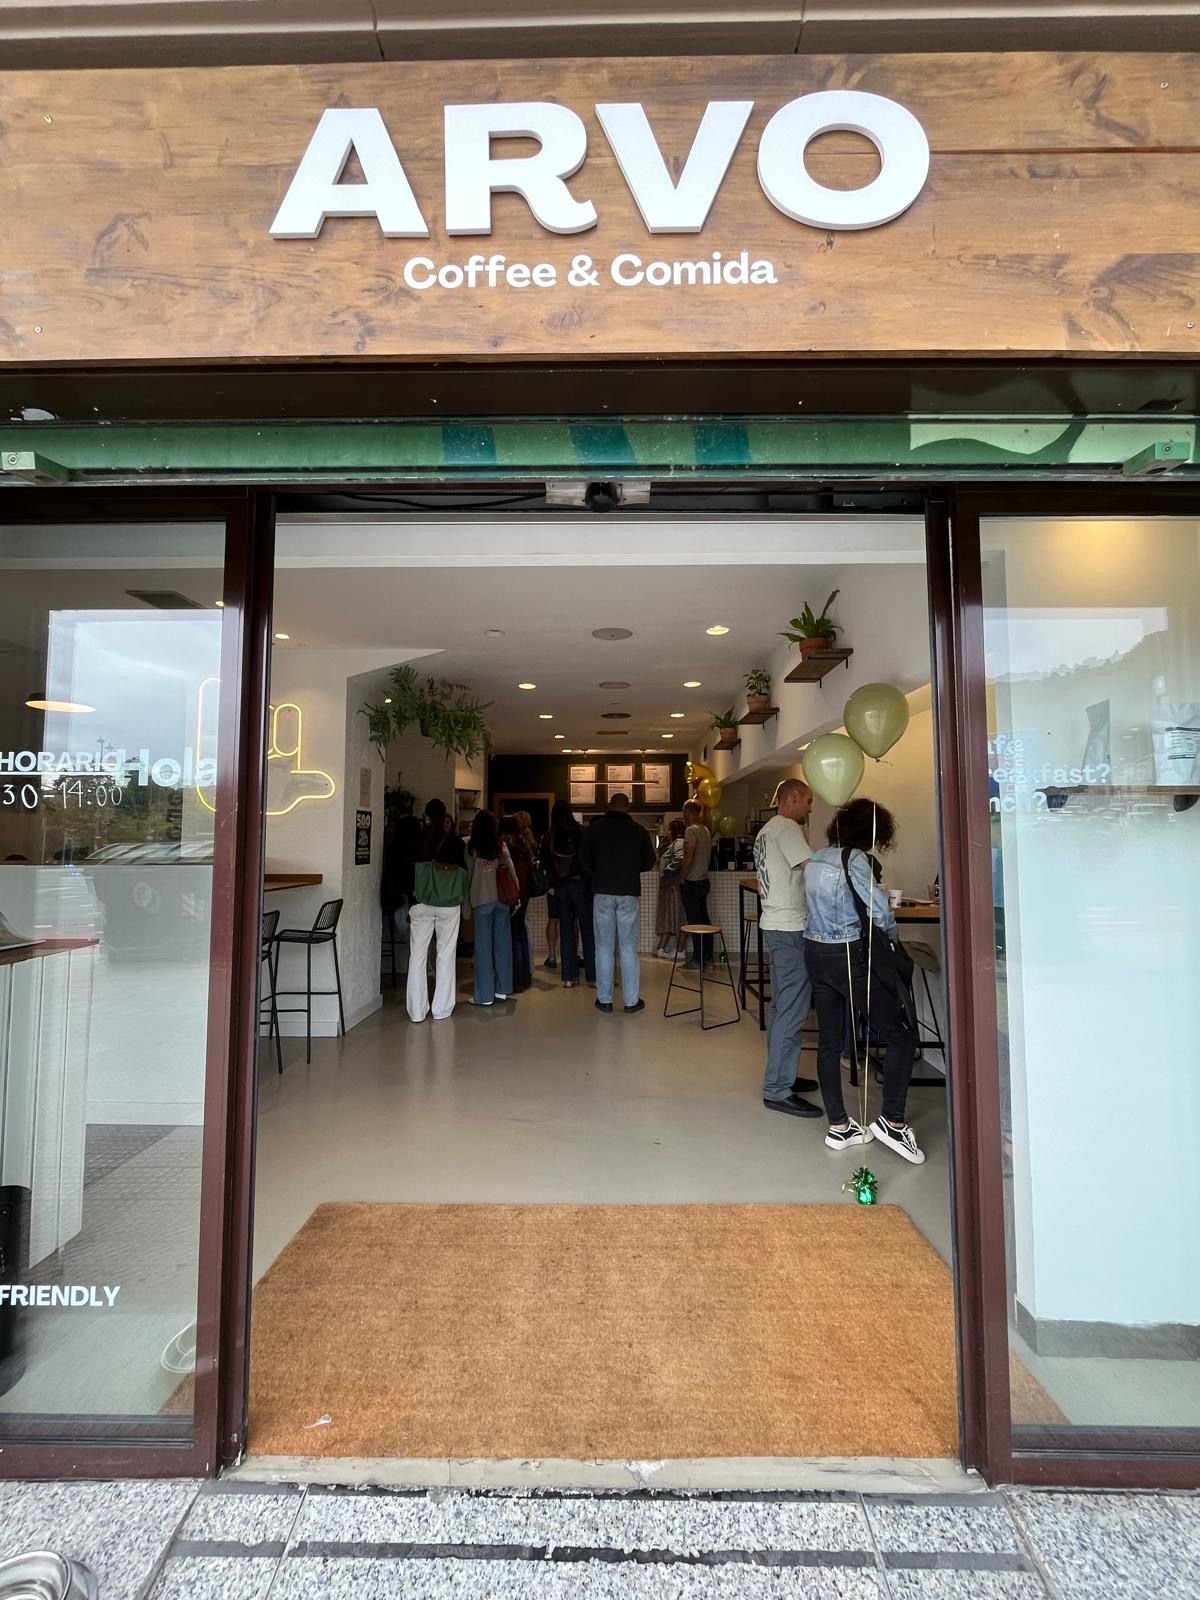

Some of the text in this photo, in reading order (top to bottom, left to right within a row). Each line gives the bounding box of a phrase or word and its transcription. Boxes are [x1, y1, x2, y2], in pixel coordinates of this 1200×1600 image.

[269, 90, 931, 238] ARVO
[403, 250, 779, 290] Coffee & Comida
[0, 751, 124, 772] HORARIO
[0, 1285, 120, 1307] FRIENDLY
